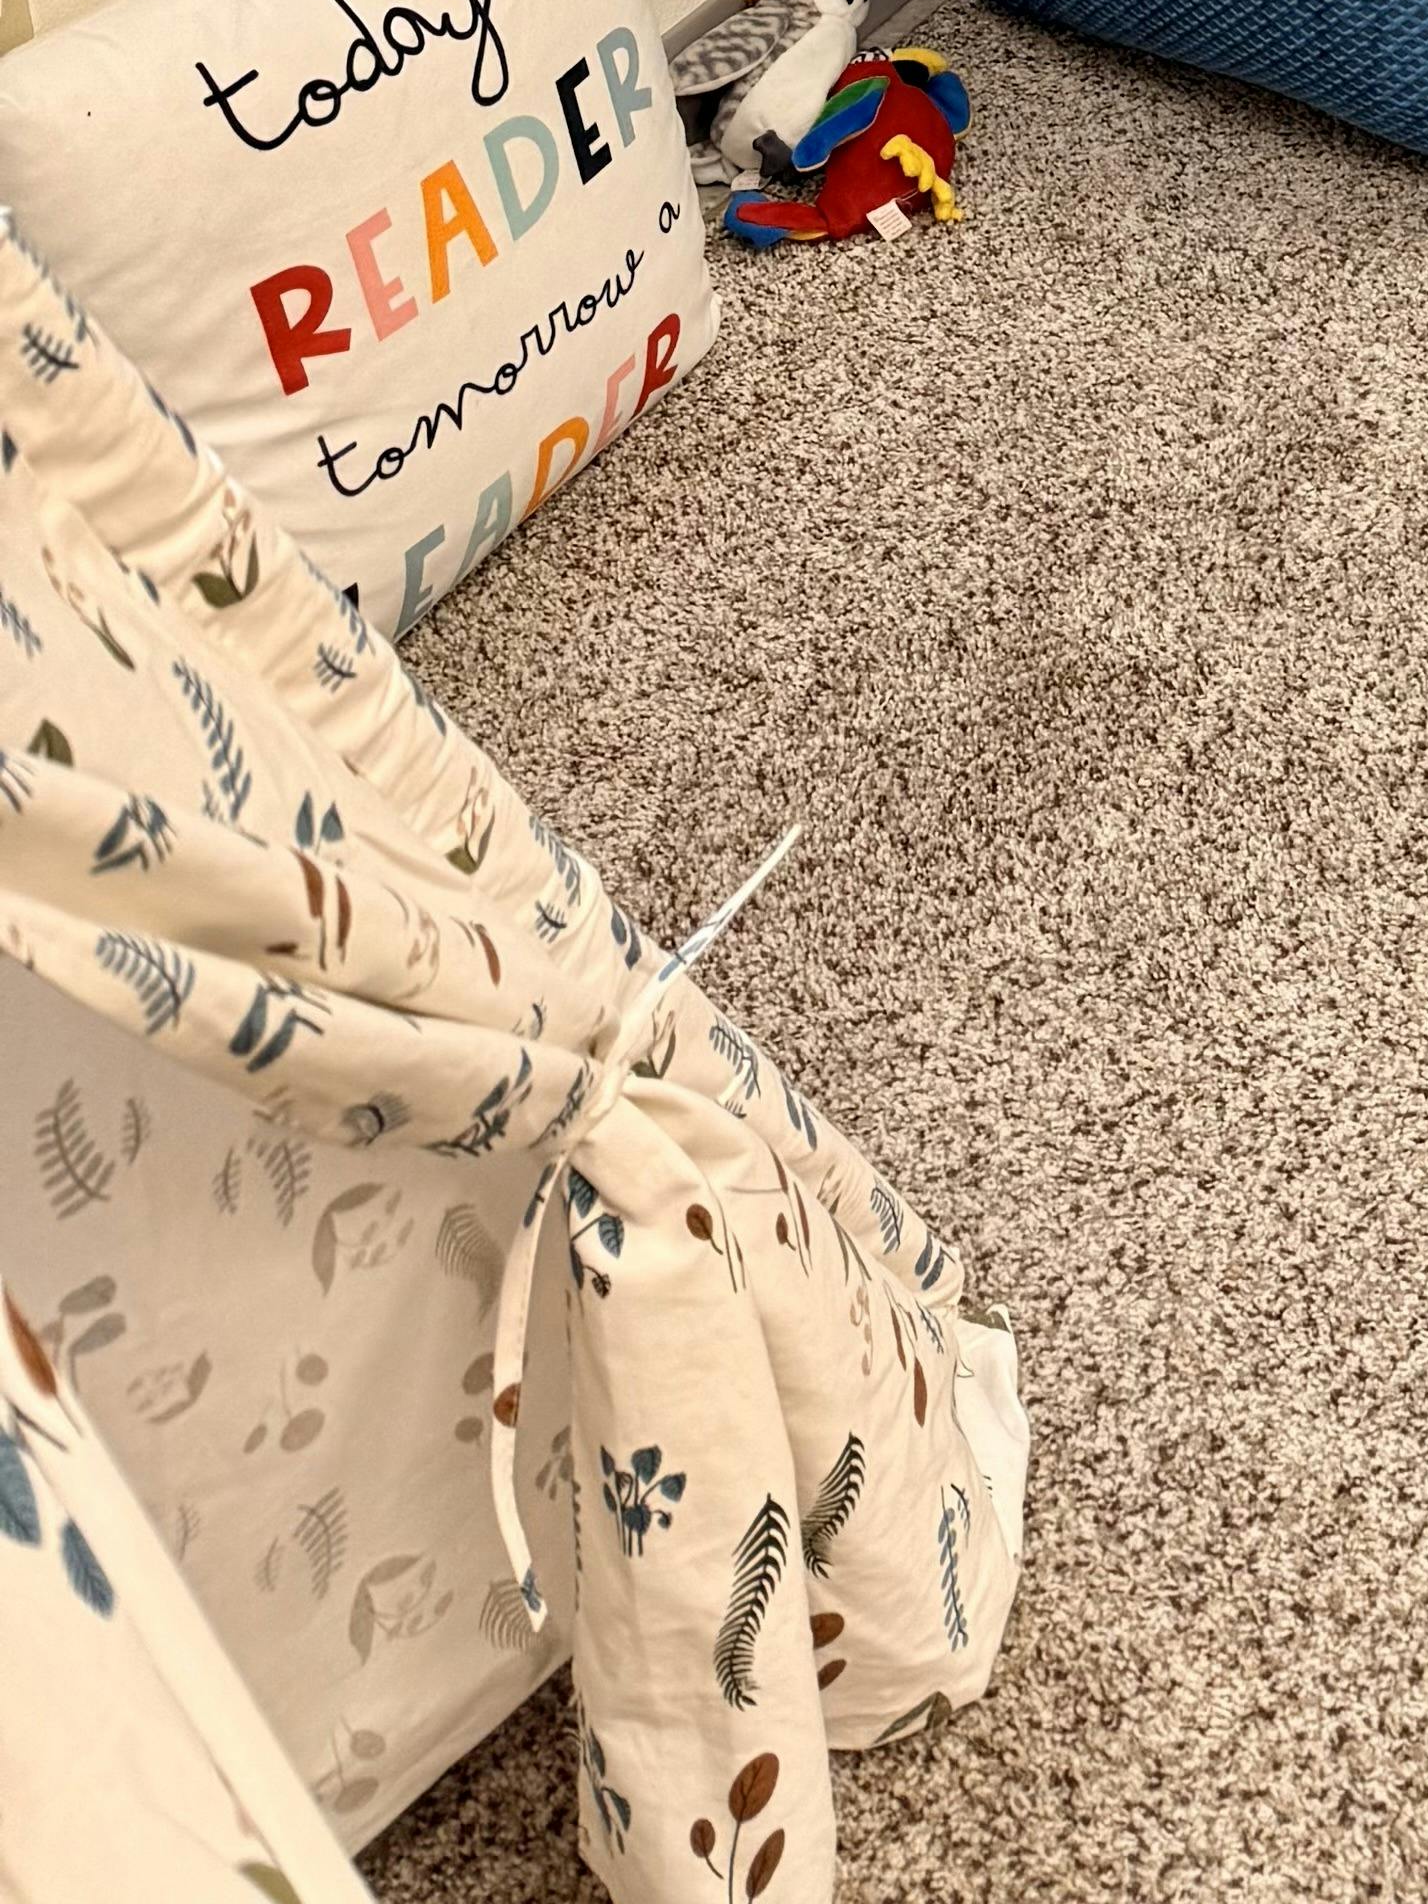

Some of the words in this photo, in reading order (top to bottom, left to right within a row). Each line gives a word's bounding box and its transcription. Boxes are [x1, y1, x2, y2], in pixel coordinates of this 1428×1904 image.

[249, 25, 654, 397] READER
[316, 247, 645, 497] tomorrow
[657, 200, 681, 235] a
[340, 311, 682, 638] EADER
